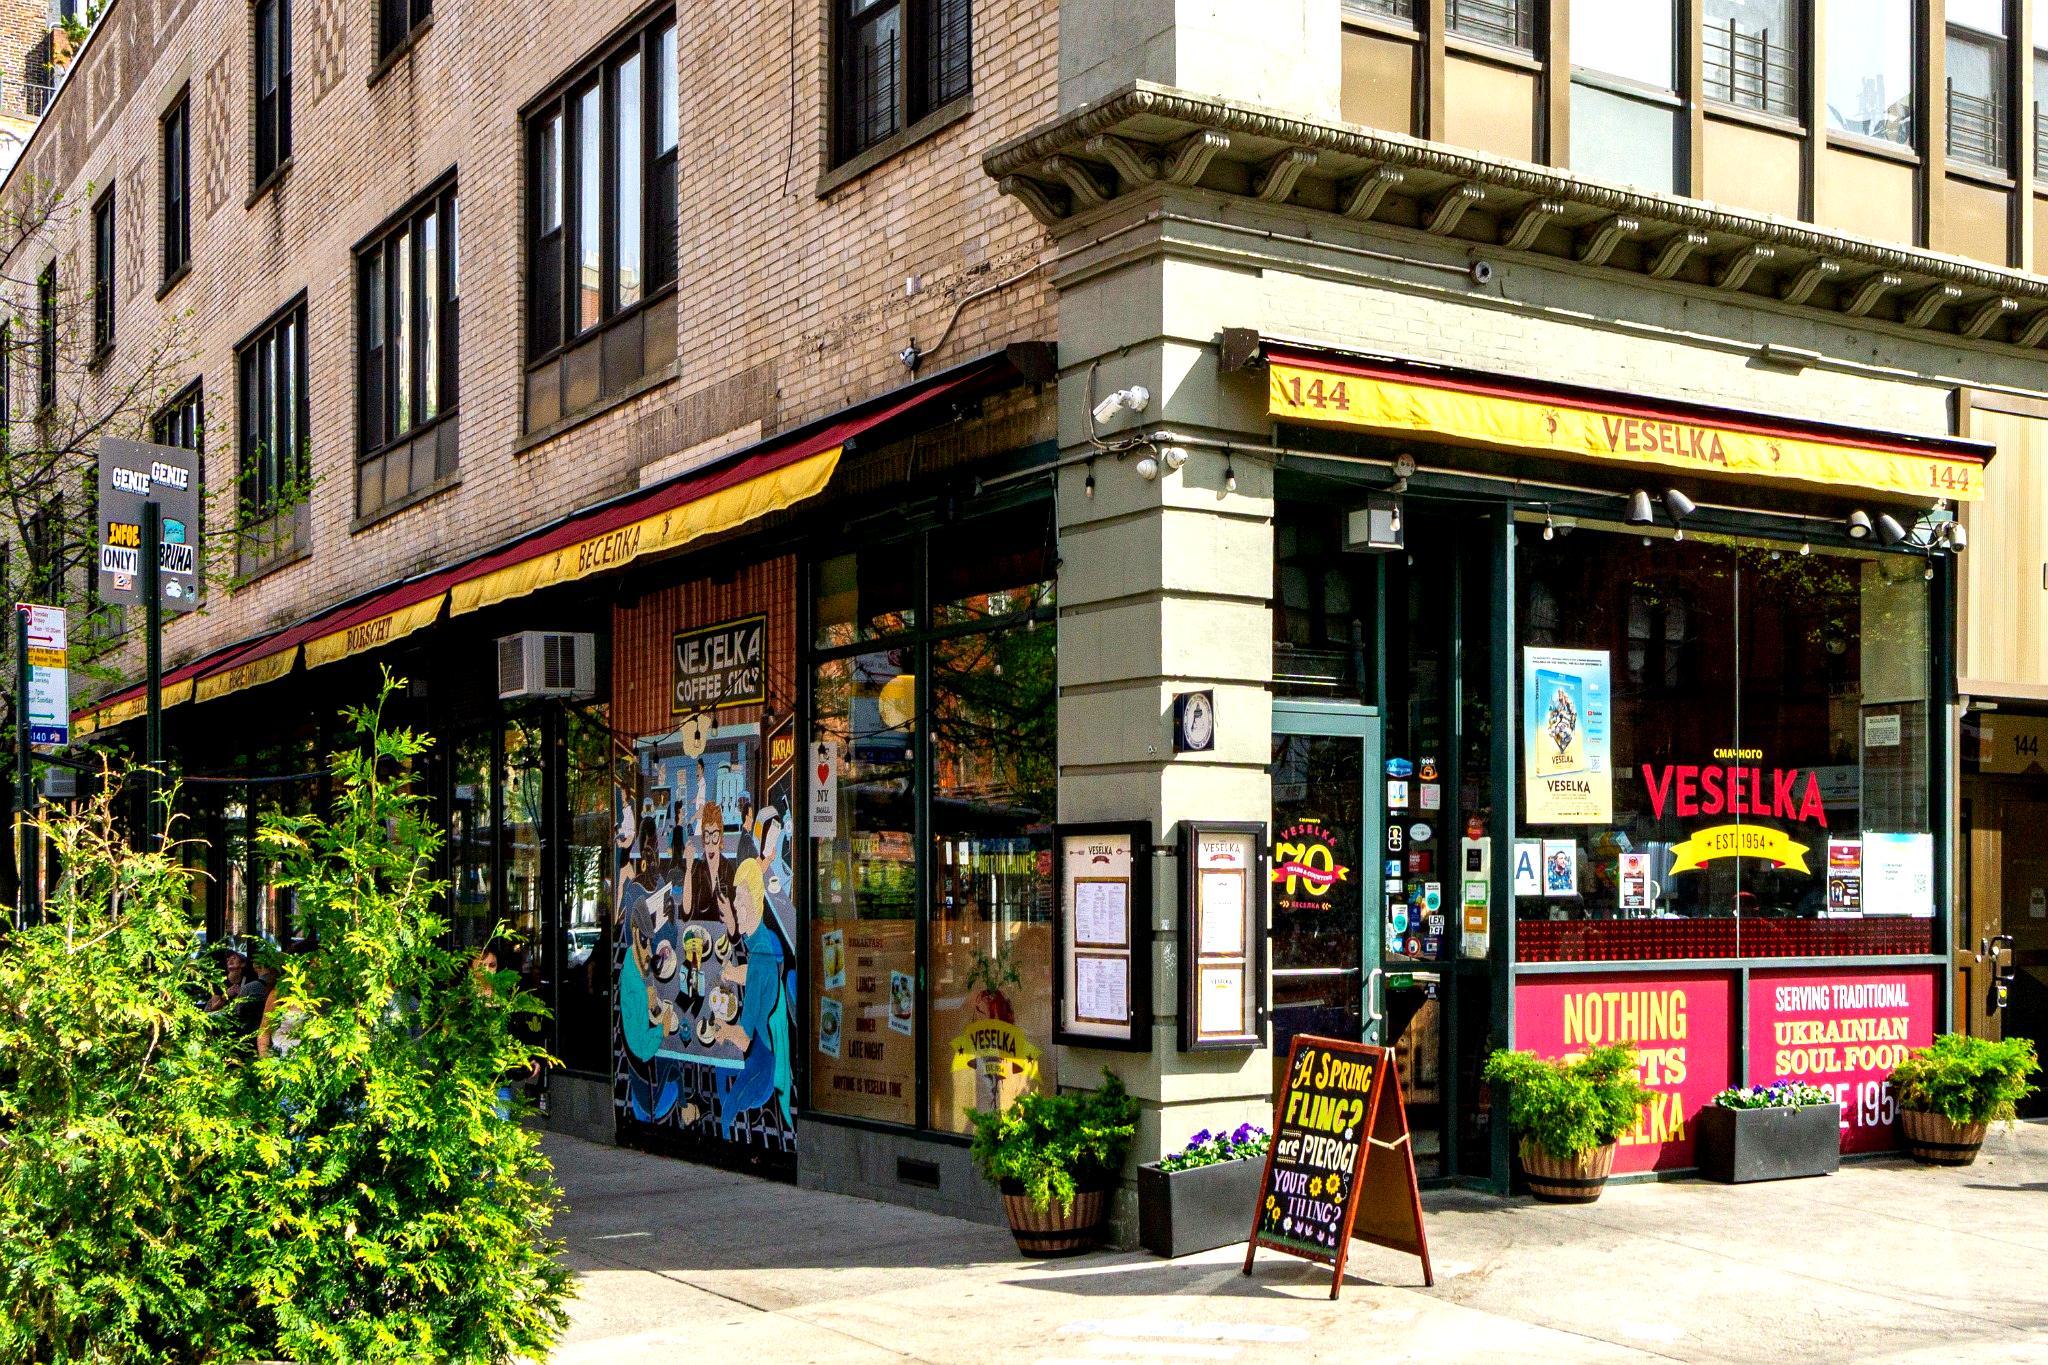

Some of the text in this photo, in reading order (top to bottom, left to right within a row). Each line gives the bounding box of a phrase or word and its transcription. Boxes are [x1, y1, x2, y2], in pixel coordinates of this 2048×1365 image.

[1289, 376, 1350, 411] 144
[1602, 416, 1729, 467] VESELKA
[1928, 463, 1970, 492] 144
[346, 617, 392, 650] BORSCHT
[676, 627, 761, 675] VESELKA
[676, 675, 721, 704] COFFEE
[2013, 734, 2039, 756] 144
[1547, 780, 1591, 794] VESELKA
[1642, 764, 1827, 828] VESELKA
[1088, 845, 1113, 856] VESELKA
[1281, 824, 1337, 847] VESELKA
[1741, 833, 1765, 850] 1954
[1276, 842, 1334, 896] 70
[1515, 850, 1535, 880] A
[1775, 982, 1909, 1012] SERVING TRADITIONAL
[1564, 990, 1687, 1044] NOTHING
[1774, 1017, 1908, 1046] UKRAINIAN
[970, 1028, 1016, 1057] VESELKA
[1292, 1050, 1372, 1093] A SPRING
[1776, 1044, 1909, 1076] SOUL FOOD
[1285, 1091, 1364, 1134] FLING?
[1857, 1081, 1902, 1126] 195
[1277, 1136, 1358, 1173] are PIEROGI
[1274, 1168, 1308, 1196] YOUR
[1287, 1196, 1342, 1223] THING?
